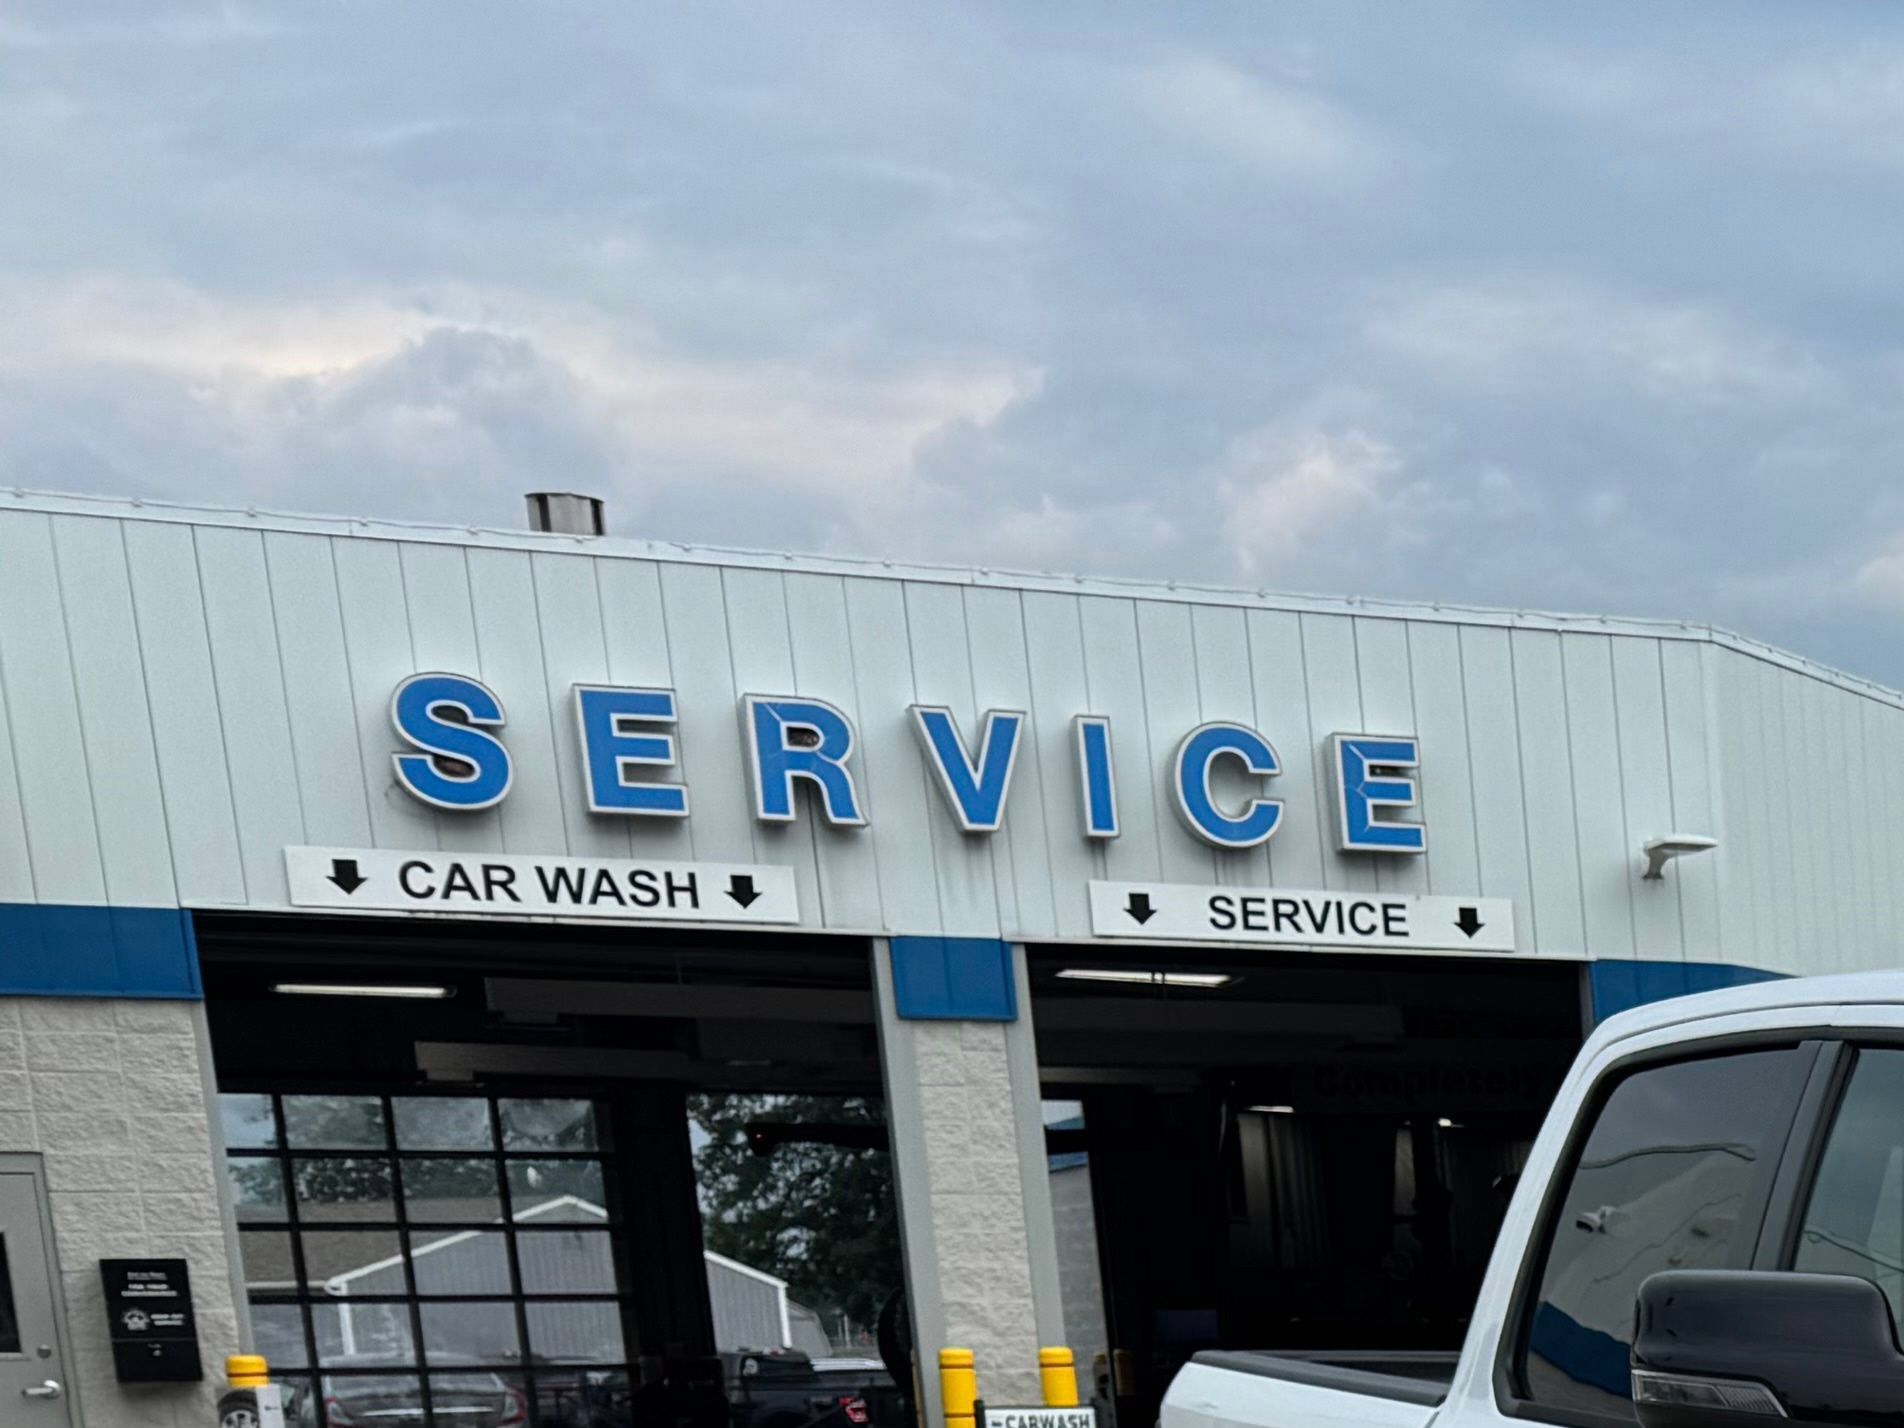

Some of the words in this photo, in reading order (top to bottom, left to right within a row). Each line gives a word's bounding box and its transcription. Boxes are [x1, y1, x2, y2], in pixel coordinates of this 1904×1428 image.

[391, 671, 1427, 855] SERVICE
[399, 860, 522, 903] CAR
[534, 865, 701, 909] WASH
[1208, 895, 1410, 937] SERVICE
